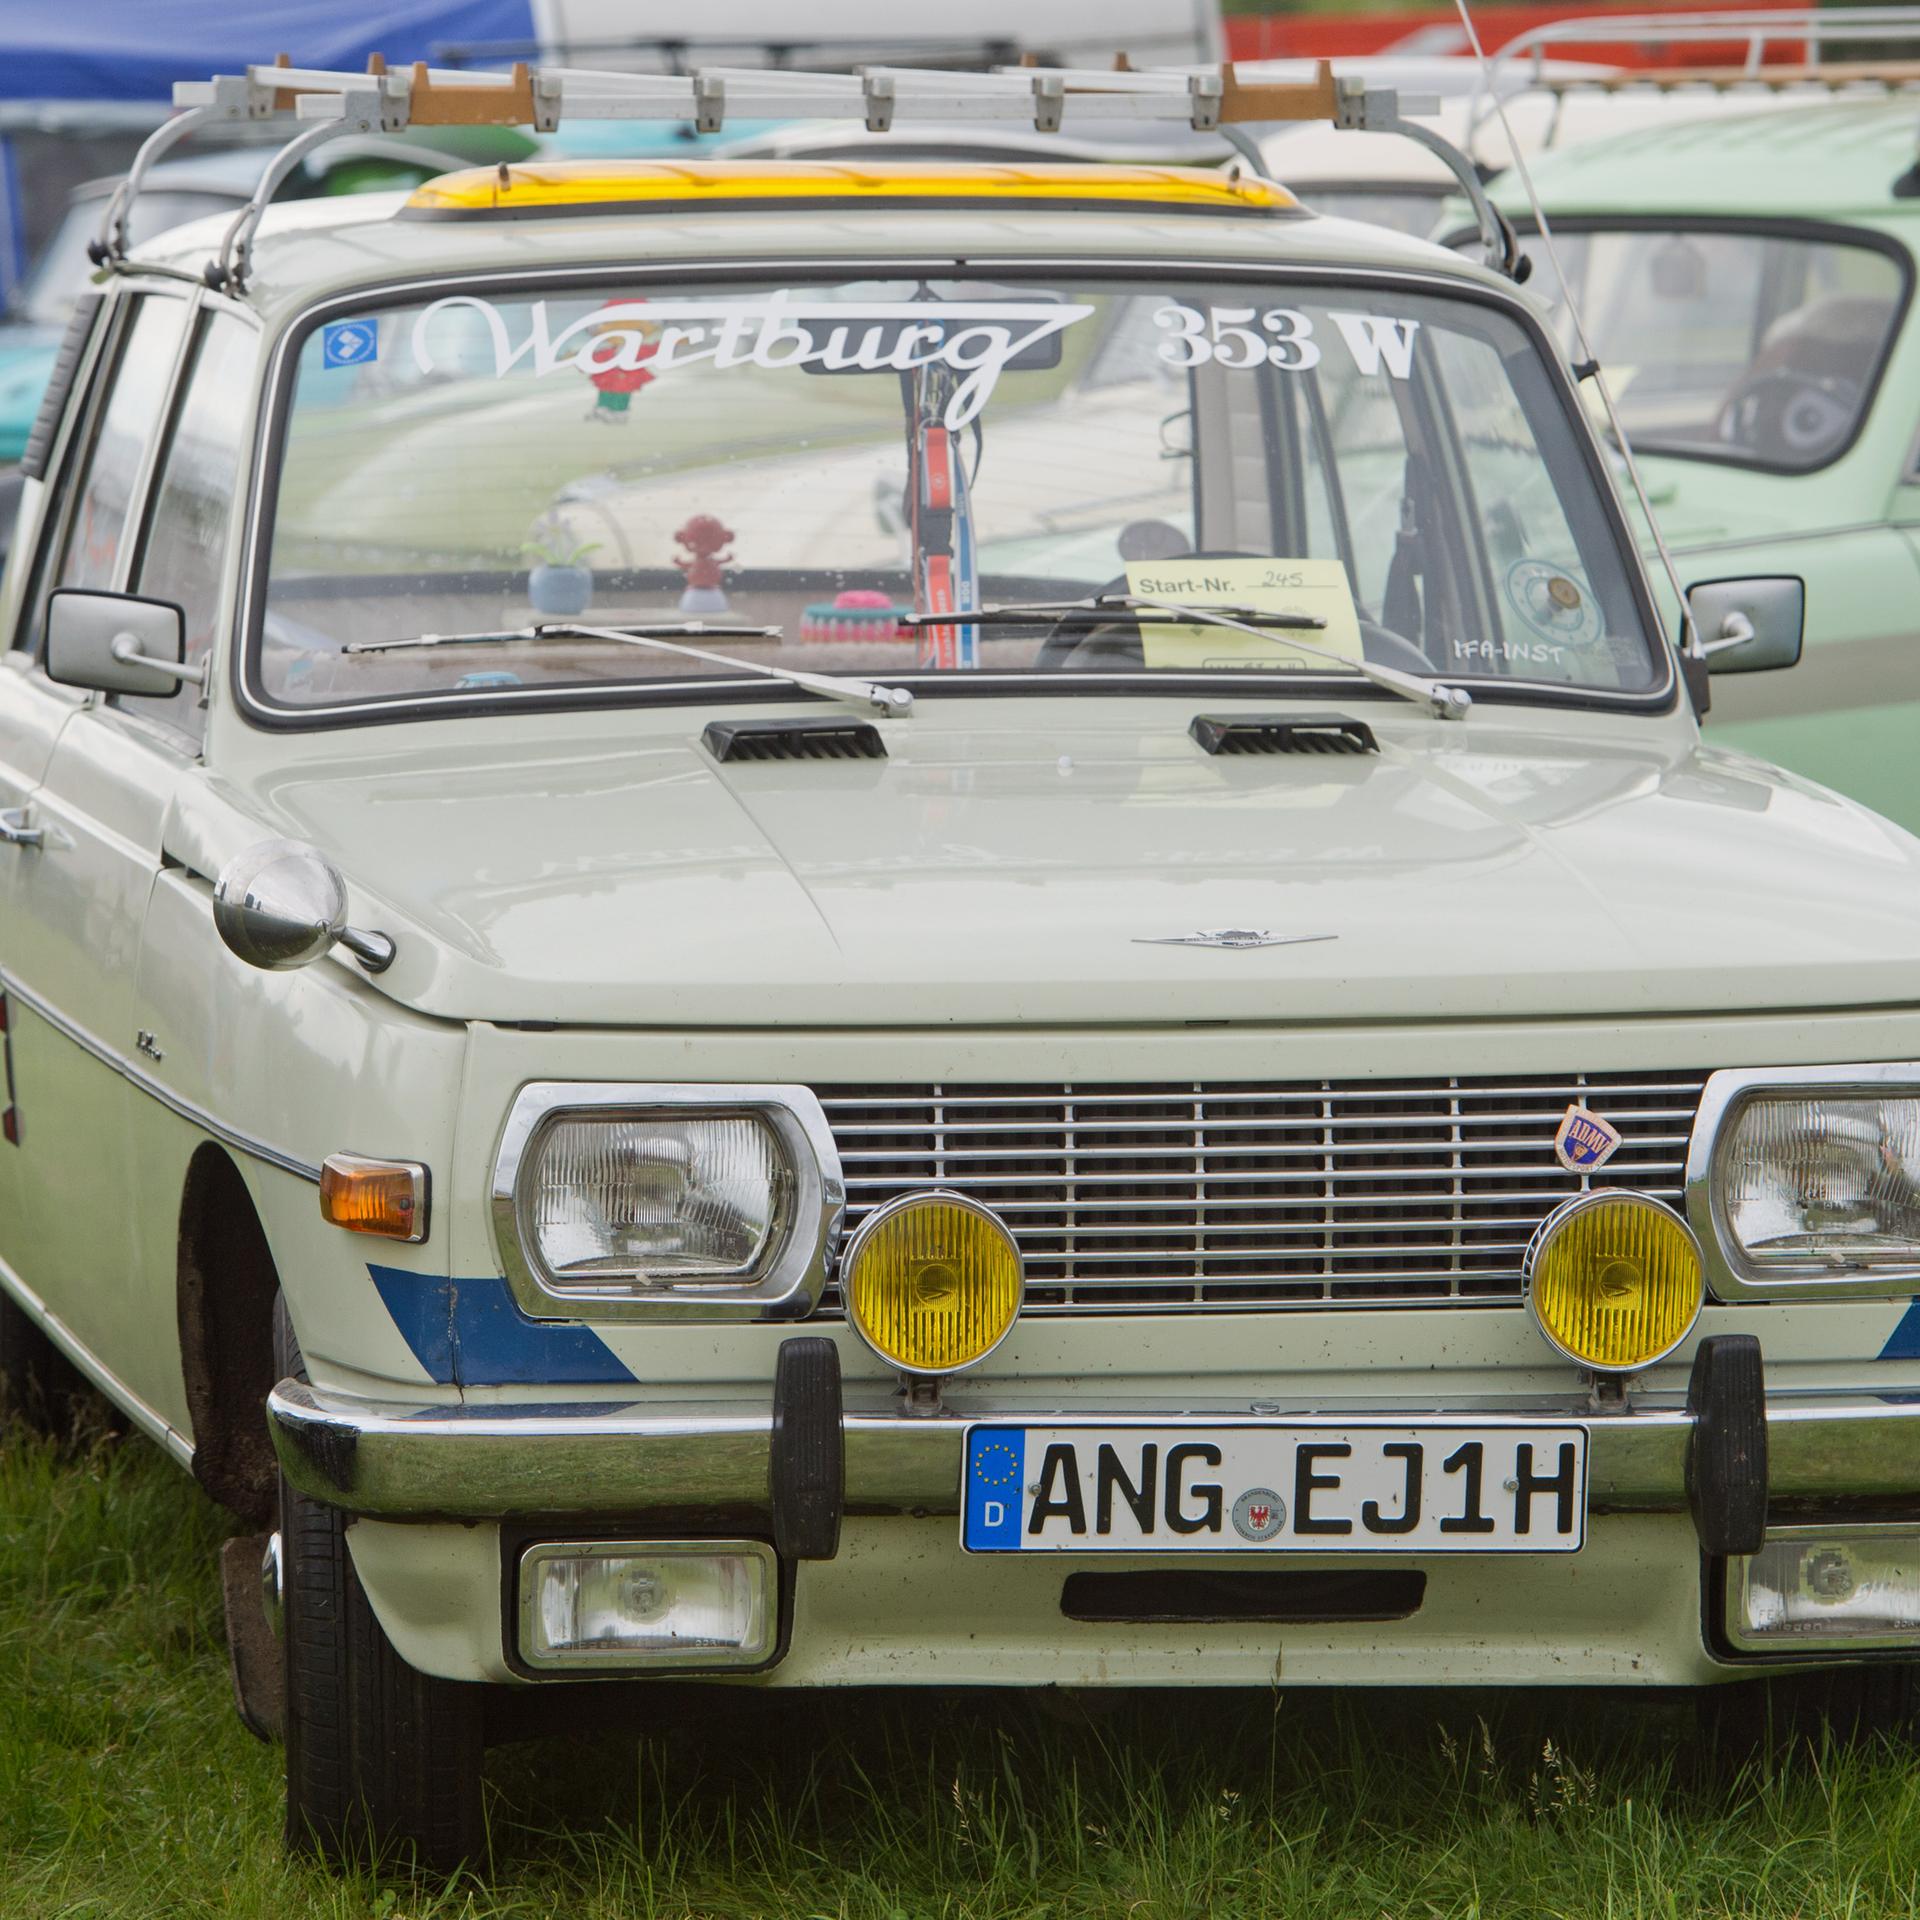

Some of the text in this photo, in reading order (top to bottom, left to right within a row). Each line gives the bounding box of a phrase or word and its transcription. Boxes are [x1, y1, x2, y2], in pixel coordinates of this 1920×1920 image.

[411, 288, 1096, 431] Wartburg
[1153, 305, 1321, 371] 353
[1327, 311, 1420, 380] W
[1140, 577, 1236, 594] Start-Nr.
[984, 1501, 1004, 1527] D
[1027, 1442, 1577, 1535] ANG EJ1H
